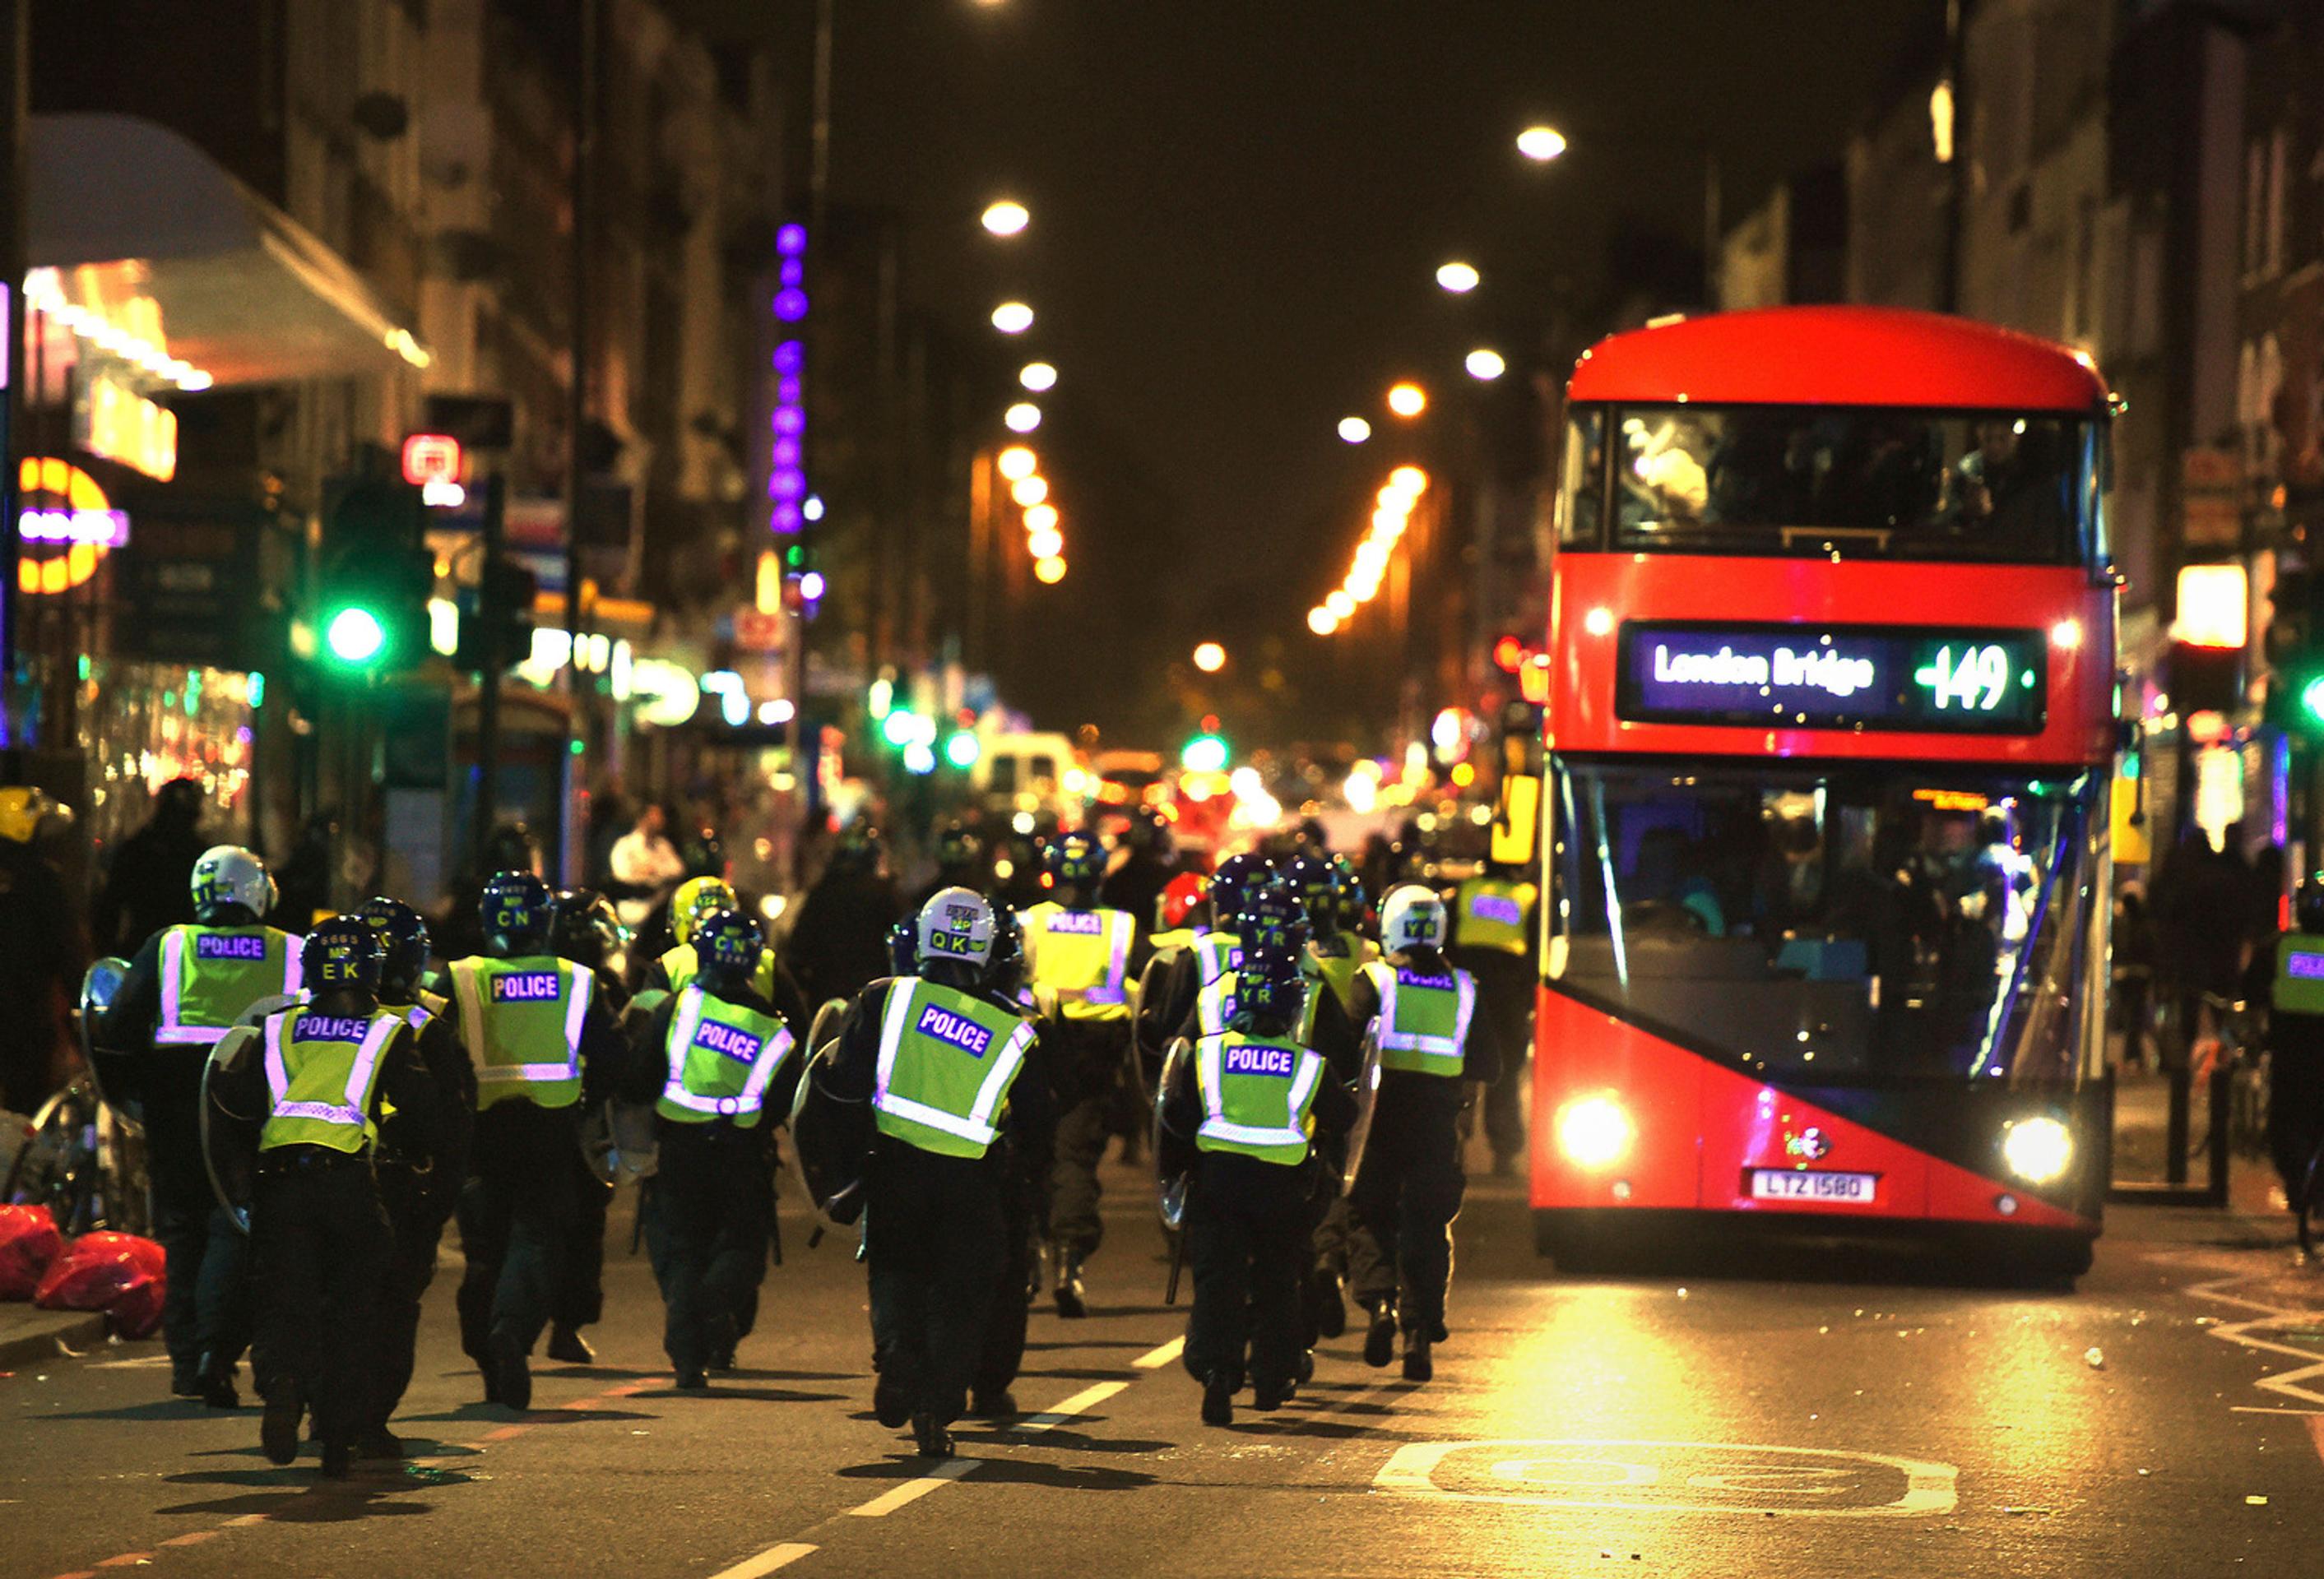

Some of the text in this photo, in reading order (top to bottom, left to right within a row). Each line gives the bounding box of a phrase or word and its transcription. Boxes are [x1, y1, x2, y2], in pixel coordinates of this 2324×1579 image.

[1654, 644, 1874, 697] London Bridge
[199, 937, 262, 956] POLICE
[932, 932, 967, 952] QK
[322, 963, 359, 979] EK
[494, 975, 558, 998] POLICE
[1241, 989, 1272, 1003] YR
[295, 1016, 367, 1039] POLICE
[920, 1007, 989, 1053] POLICE
[696, 1022, 758, 1061] POLICE
[1227, 1049, 1292, 1072] POLICE
